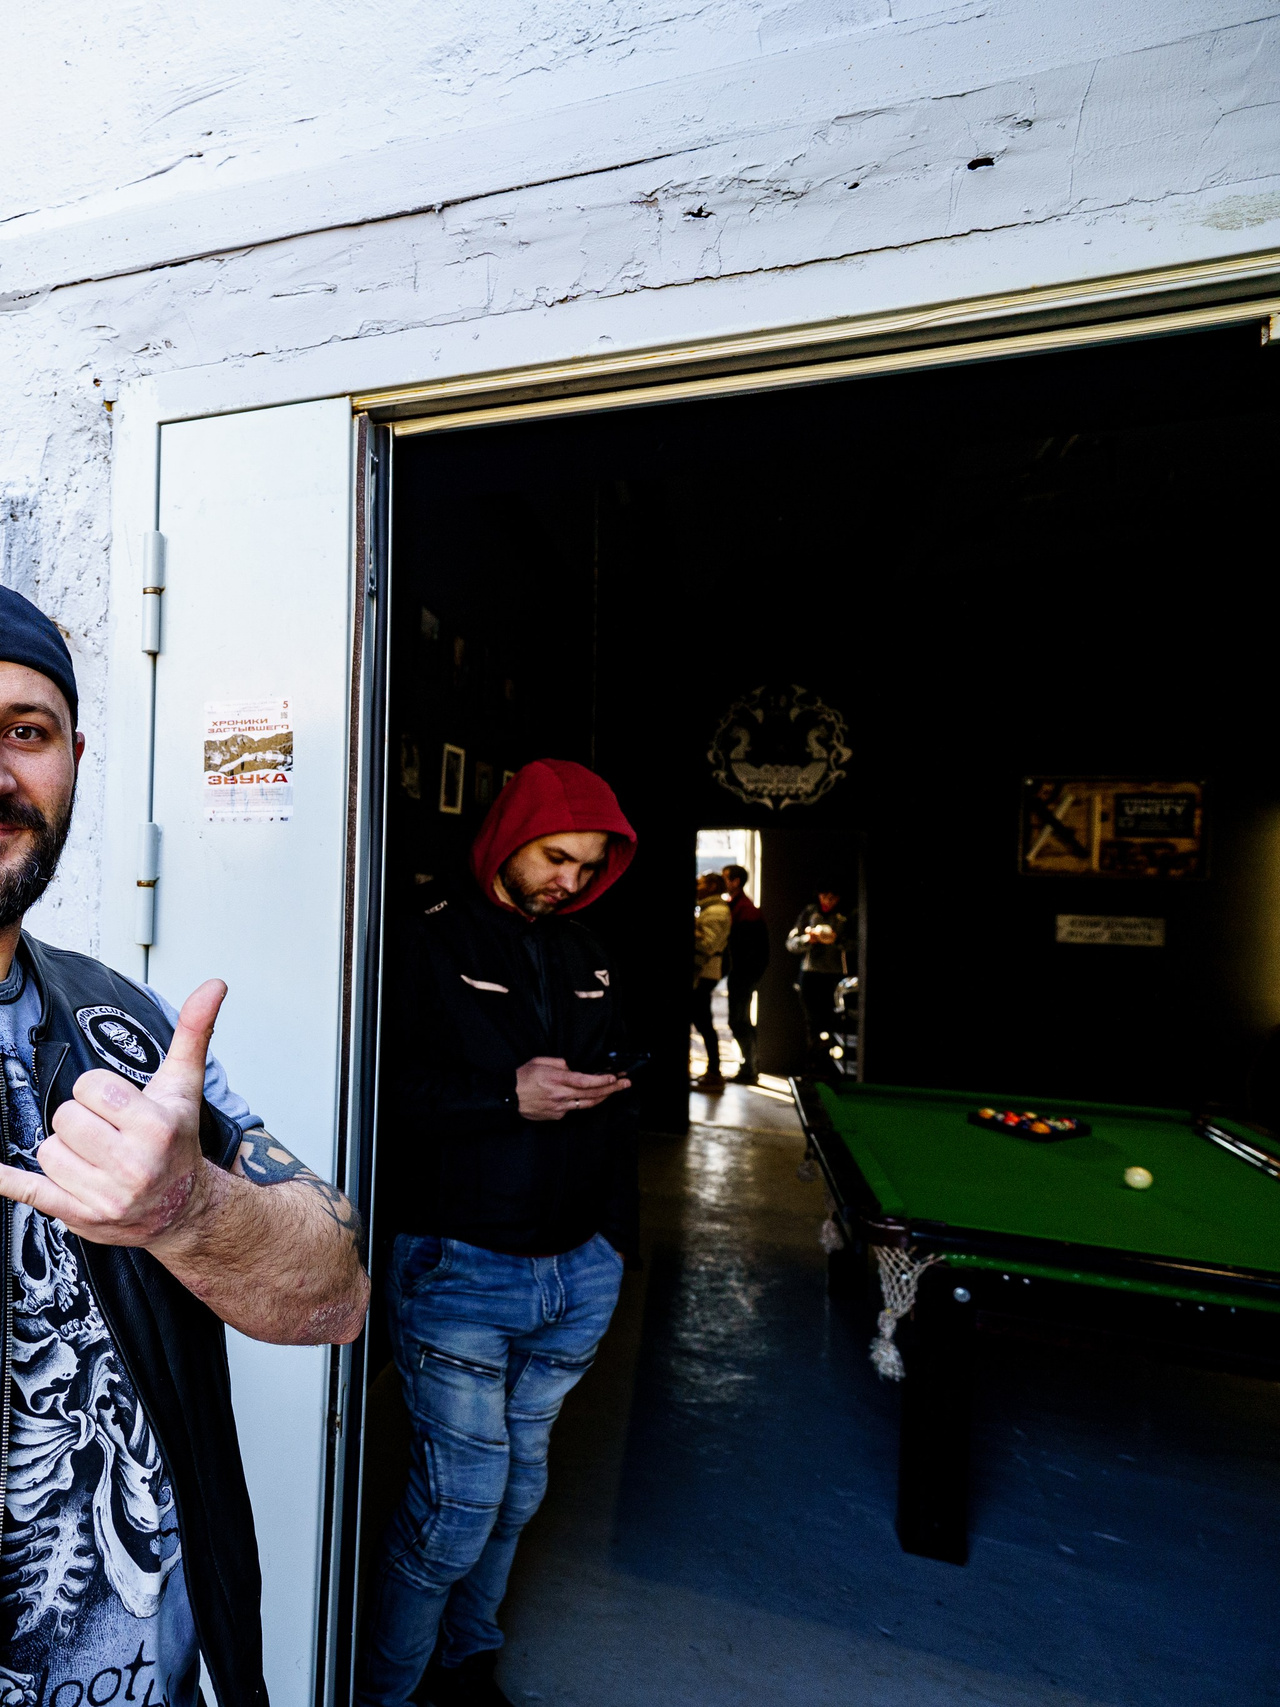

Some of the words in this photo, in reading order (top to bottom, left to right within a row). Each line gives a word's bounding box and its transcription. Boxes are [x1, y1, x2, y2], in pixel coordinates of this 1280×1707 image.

[282, 700, 289, 709] 5
[212, 718, 269, 727] ХРОНИКИ
[207, 724, 290, 734] ЗАСТЫВШЕГО
[207, 773, 289, 786] ЗВУКА
